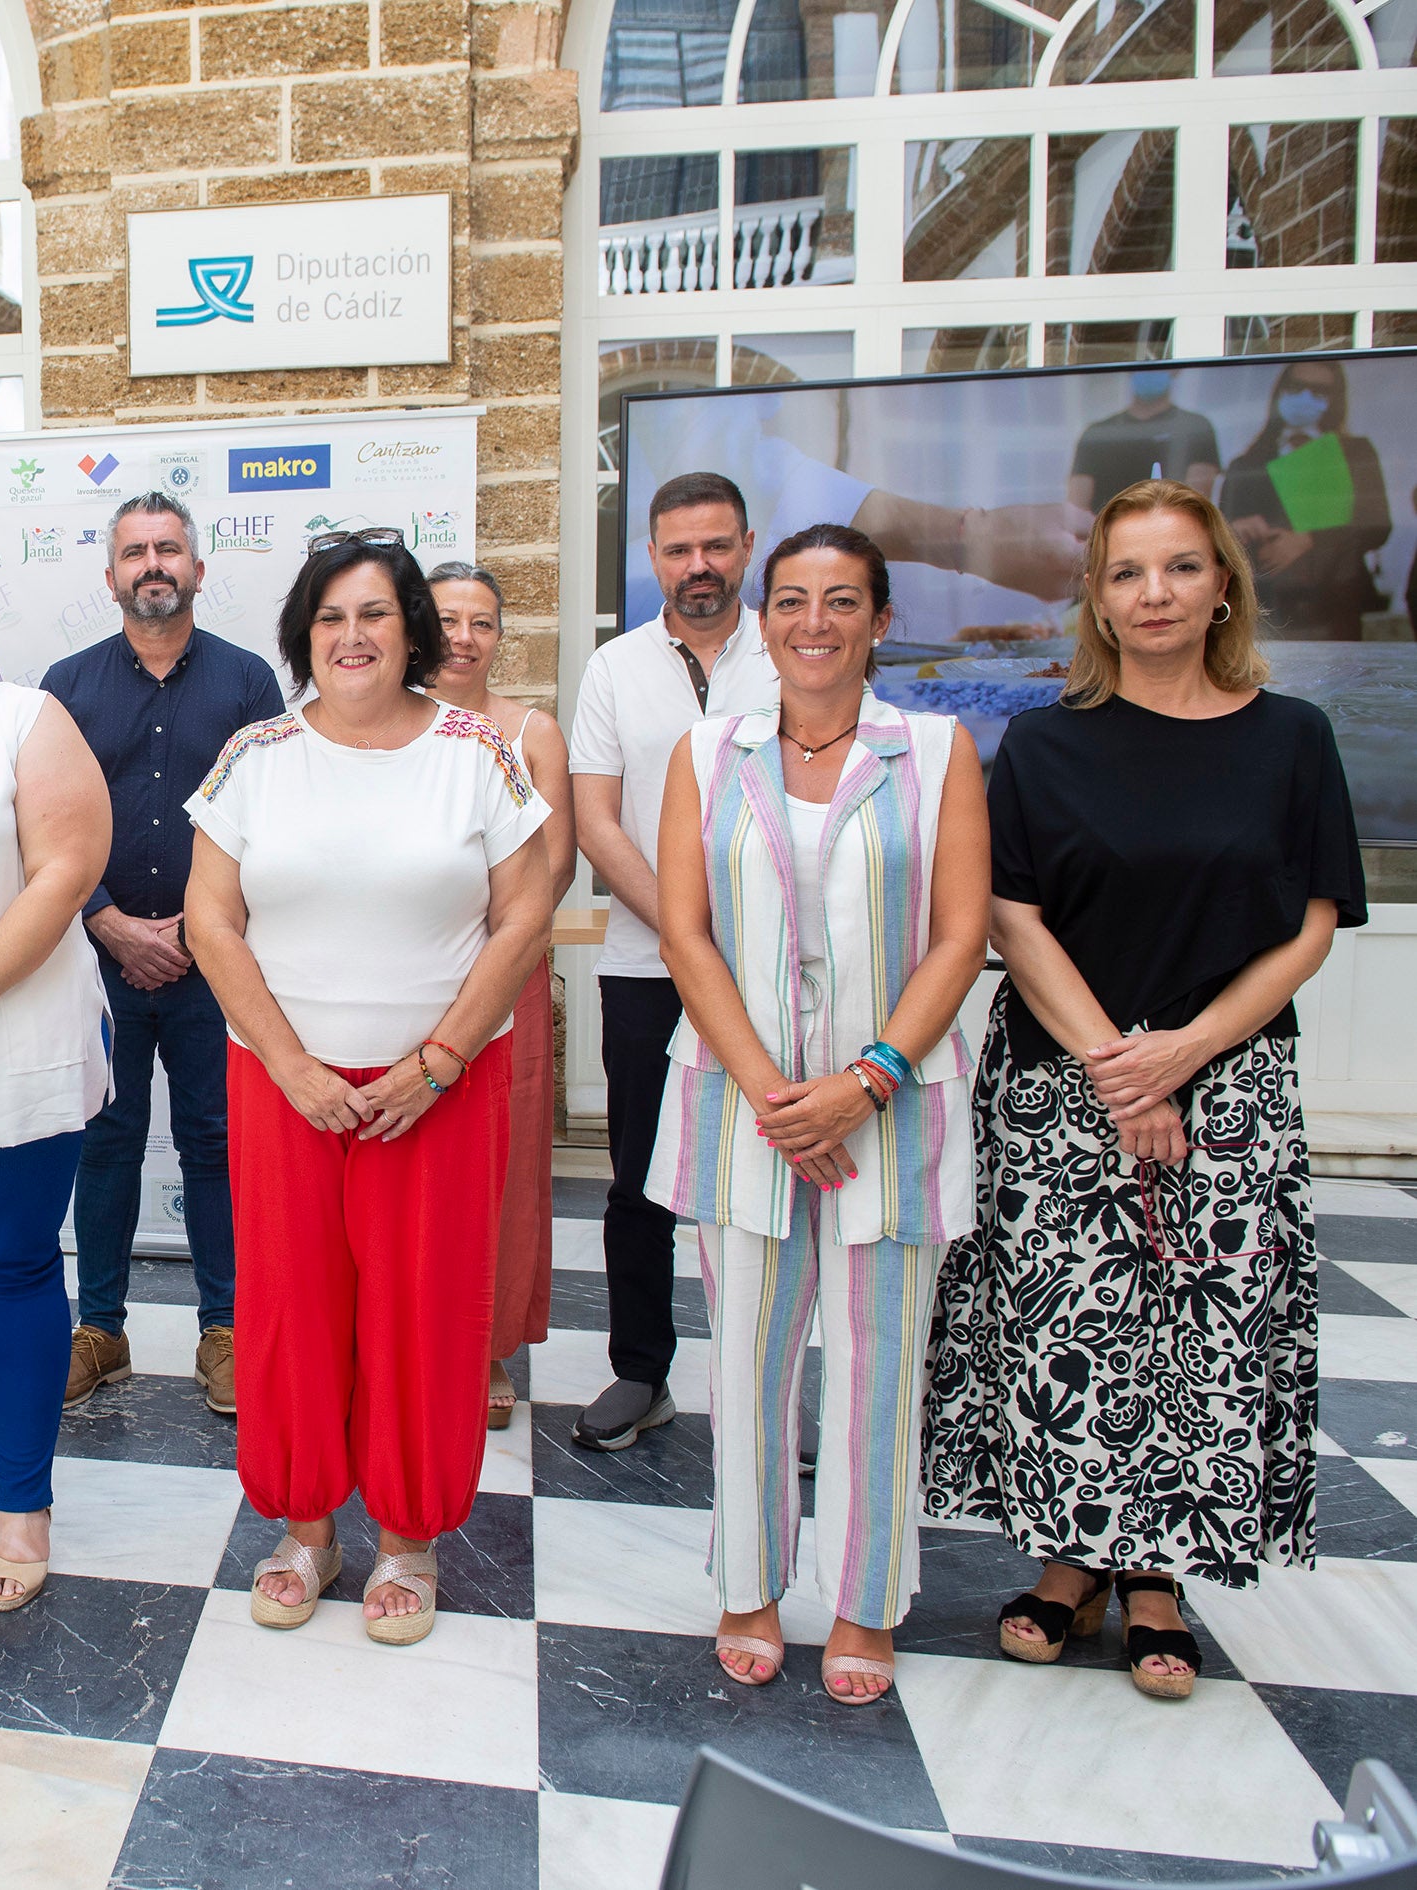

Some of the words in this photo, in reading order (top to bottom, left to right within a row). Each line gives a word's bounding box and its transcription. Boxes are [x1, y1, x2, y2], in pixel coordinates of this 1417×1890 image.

[276, 246, 431, 285] Diputación
[276, 294, 311, 323] de
[324, 290, 403, 322] Cádiz
[160, 456, 199, 464] ROMEGAL
[242, 457, 317, 479] makro
[20, 493, 42, 503] gazul
[77, 487, 122, 496] lavozdelsur.es
[216, 516, 275, 537] CHEF
[411, 524, 457, 550] Janda
[209, 524, 250, 554] Janda
[21, 540, 62, 565] Janda
[62, 587, 115, 628] CHE
[162, 1203, 181, 1223] LONDON
